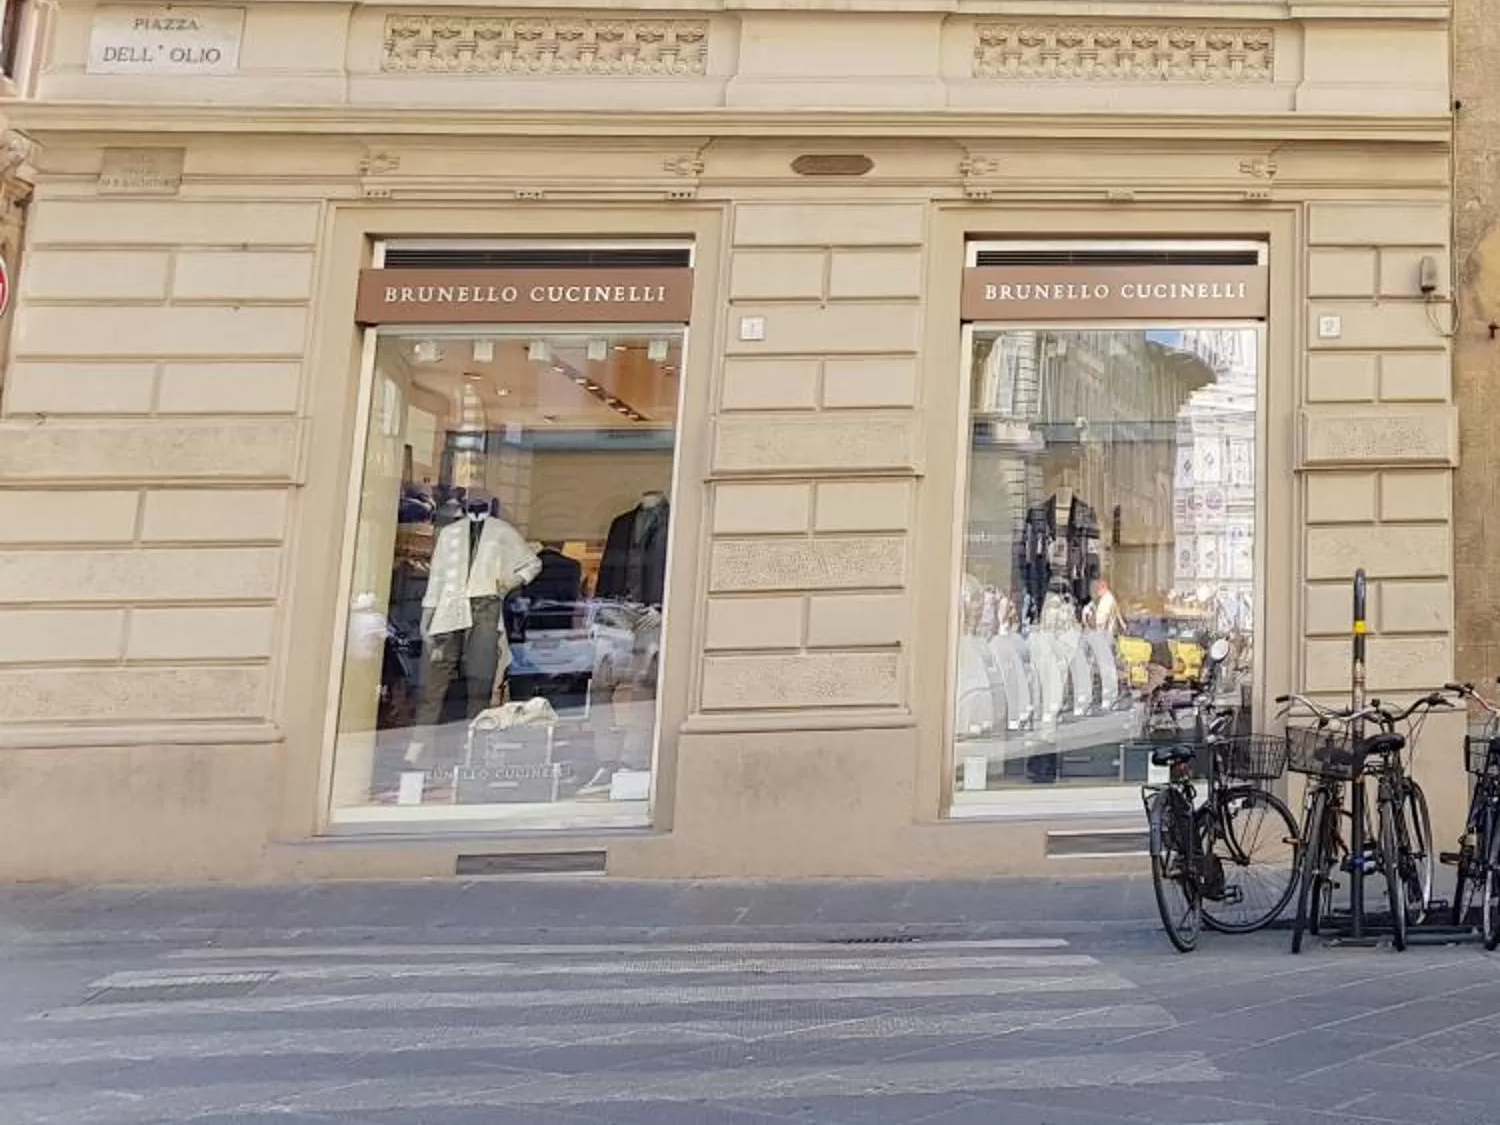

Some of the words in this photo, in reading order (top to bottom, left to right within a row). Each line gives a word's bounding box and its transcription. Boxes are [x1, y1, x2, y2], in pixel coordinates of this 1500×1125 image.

[134, 18, 199, 30] PIAZZA
[169, 47, 221, 63] OLIO
[384, 286, 518, 302] BRUNELLO
[529, 286, 665, 302] CUCINELLI
[984, 283, 1109, 300] BRUNELLO
[1120, 283, 1246, 299] CUCINELLI
